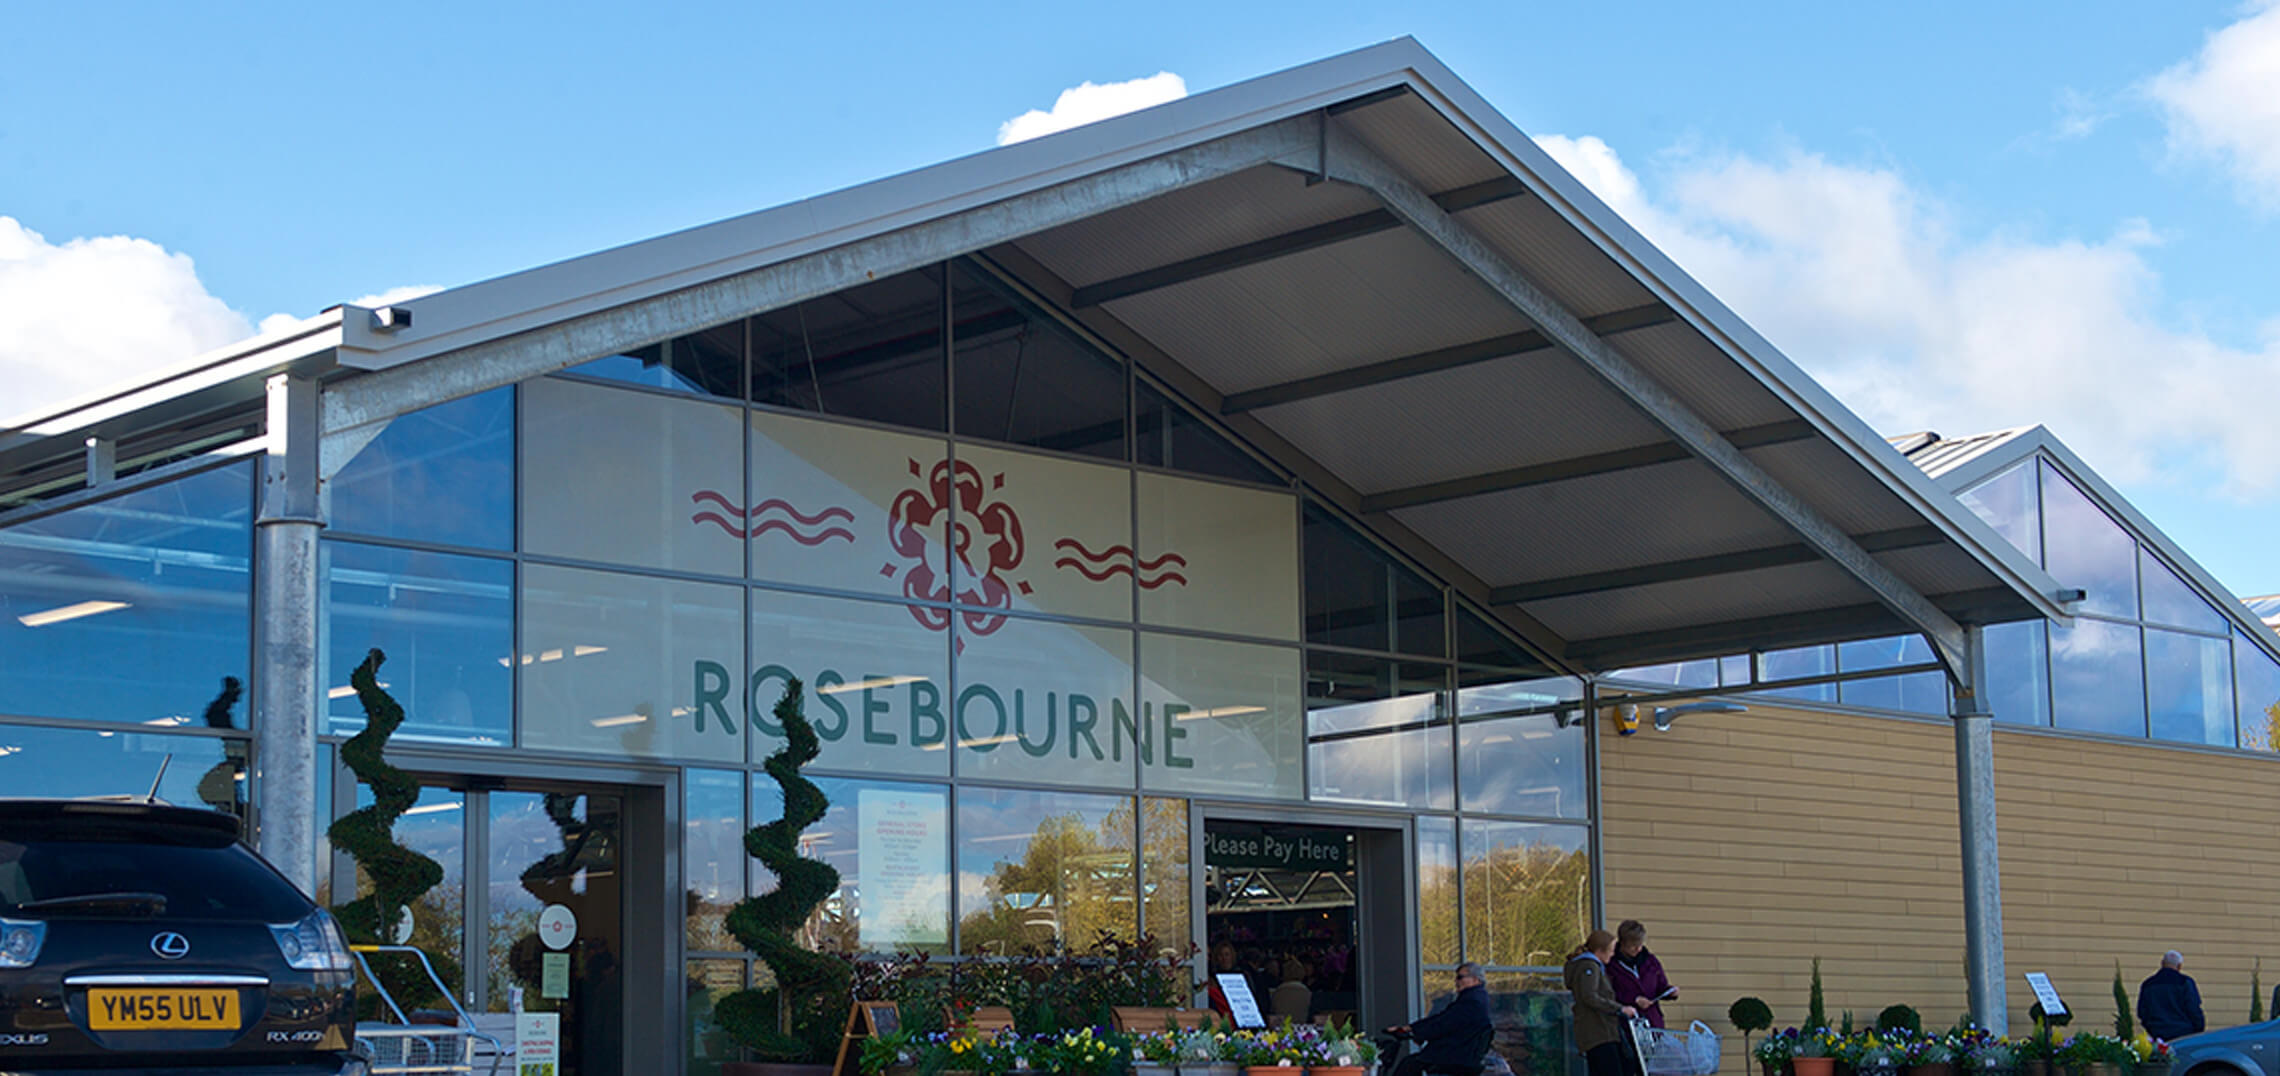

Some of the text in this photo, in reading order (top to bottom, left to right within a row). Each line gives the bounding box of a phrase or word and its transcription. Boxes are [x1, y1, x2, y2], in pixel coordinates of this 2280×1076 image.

[945, 520, 978, 578] R
[694, 660, 1194, 768] ROSEBOURNE
[1264, 835, 1294, 863] Pay
[1299, 838, 1339, 861] Here
[101, 995, 227, 1021] YM55 ULV
[266, 1031, 289, 1042] RX
